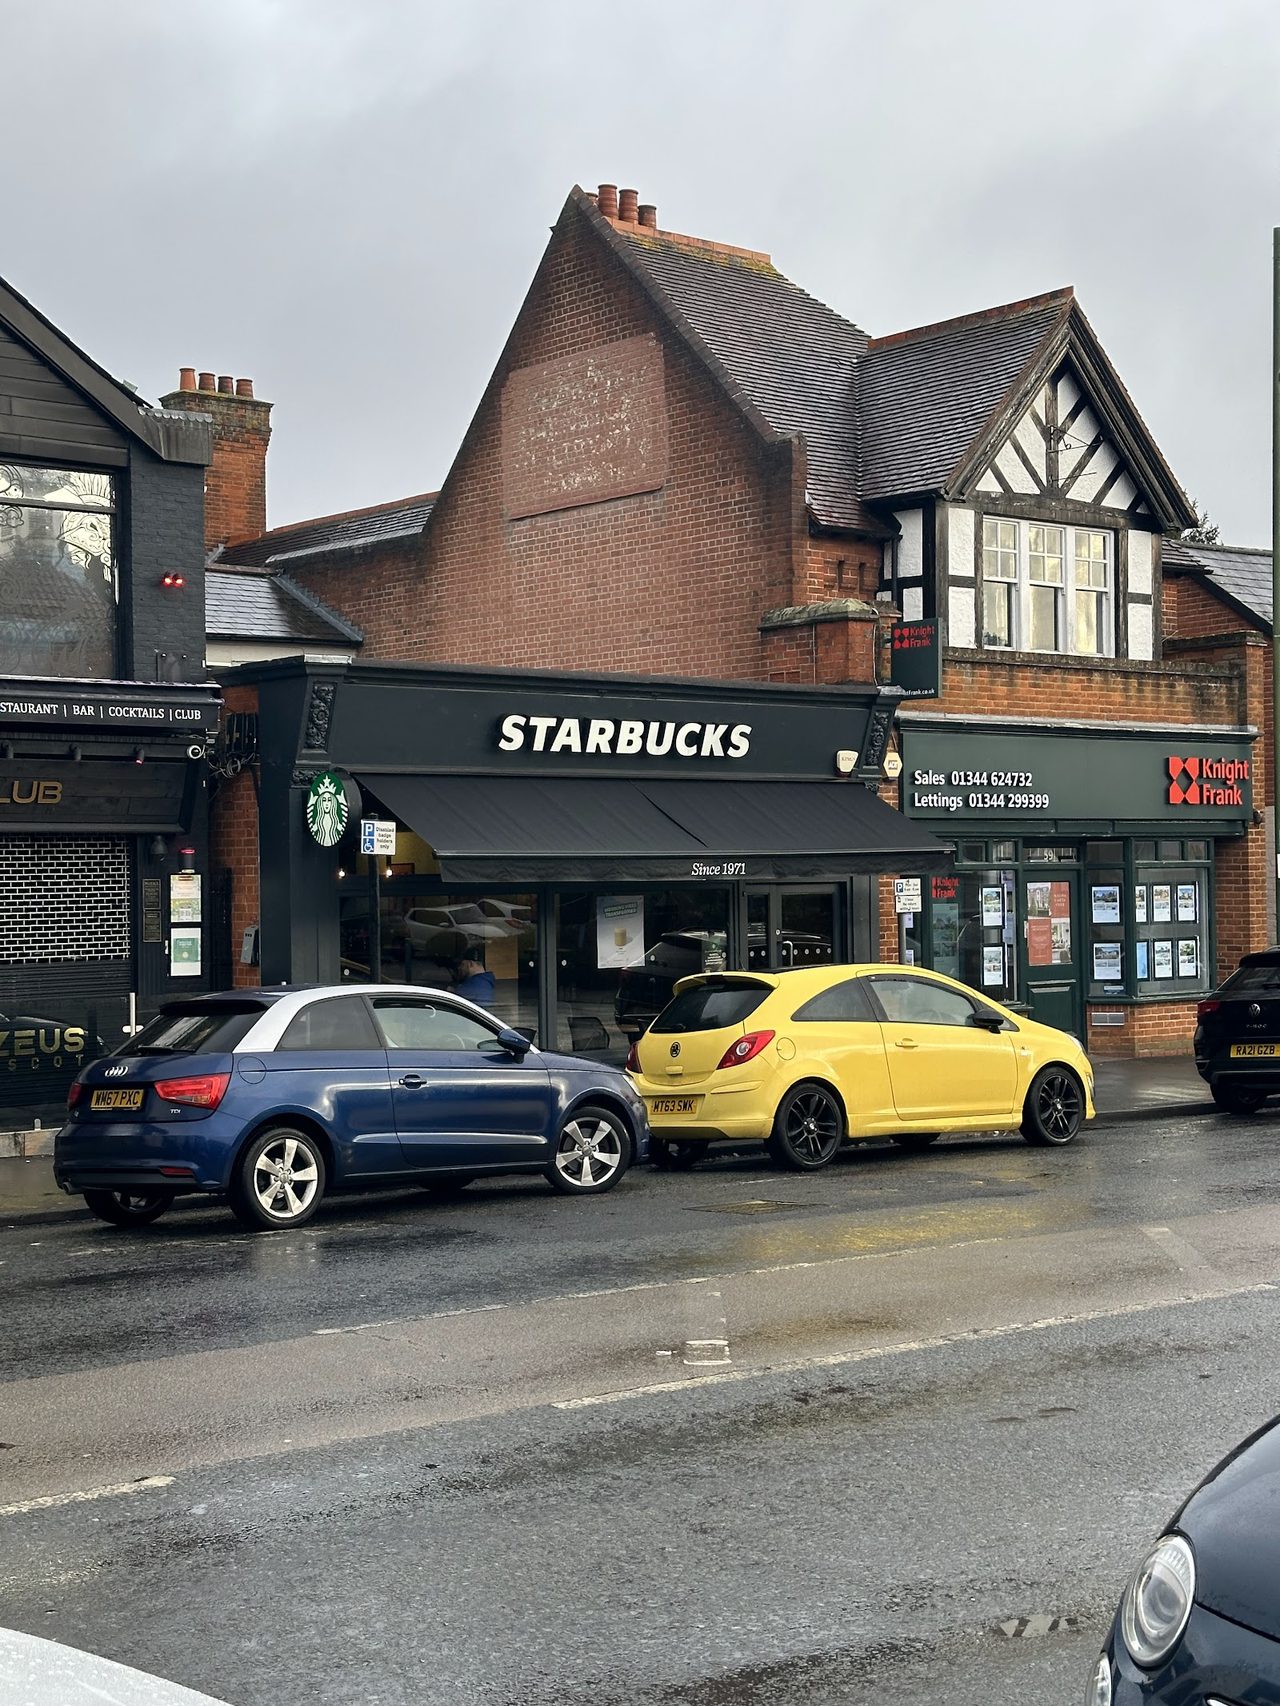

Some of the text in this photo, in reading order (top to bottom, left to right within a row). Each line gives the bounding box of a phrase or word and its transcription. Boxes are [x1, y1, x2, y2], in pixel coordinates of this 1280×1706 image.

[910, 625, 935, 637] Knight
[910, 637, 931, 648] Frank
[72, 705, 95, 716] BAR
[108, 706, 165, 719] COCKTAILS
[174, 709, 201, 720] CLUB
[498, 714, 752, 758] STARBUCKS
[1203, 757, 1249, 784] Knight
[914, 770, 1033, 786] Sales 01344 624732
[1203, 783, 1243, 805] Frank
[914, 792, 1050, 811] Lettings 01344 299399
[691, 862, 746, 876] Since 1971
[937, 877, 960, 888] Knight
[937, 889, 956, 898] Frank
[1236, 1045, 1276, 1056] RA21 GZB
[120, 1091, 140, 1106] PXC
[653, 1100, 675, 1112] MT63
